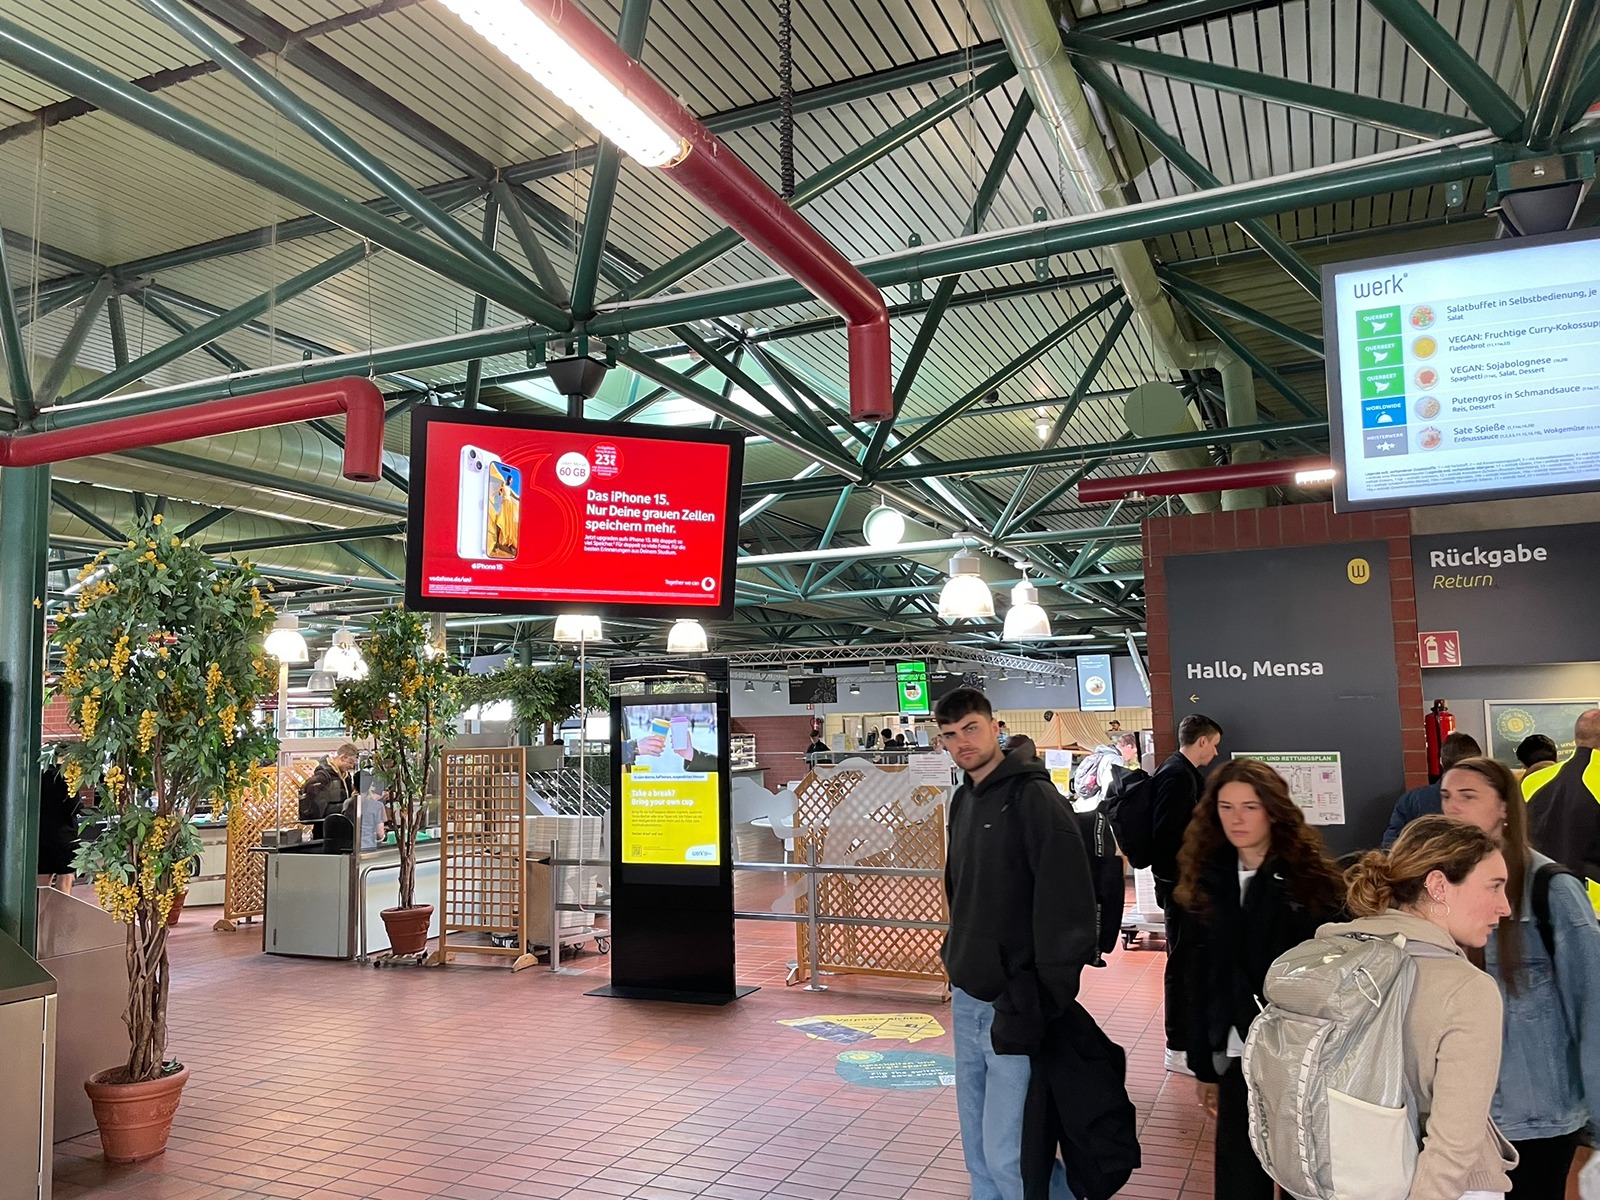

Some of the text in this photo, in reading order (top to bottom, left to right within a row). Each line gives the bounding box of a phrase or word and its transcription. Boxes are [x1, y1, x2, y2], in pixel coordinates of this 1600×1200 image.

[1447, 301, 1497, 313] Salatbuffet
[1509, 291, 1587, 305] Selbstbedienung,
[1588, 288, 1597, 298] je
[1363, 313, 1393, 321] QUERBEET
[1448, 333, 1483, 343] VEGAN:
[1485, 328, 1526, 339] Fruchtige
[1364, 343, 1395, 352] QUERBEET
[1449, 343, 1485, 351] Fladenbrot
[1450, 364, 1484, 374] VEGAN:
[1486, 358, 1551, 371] Sojabolognese
[1366, 373, 1397, 382] QUERBEET
[1450, 374, 1483, 382] Spaghetti
[1518, 367, 1545, 375] Dessert
[1452, 393, 1502, 405] Putengyros
[1504, 391, 1512, 399] in
[1514, 385, 1581, 398] Schmandsauce
[1365, 402, 1401, 411] WORLDWIDE
[1469, 403, 1495, 411] Dessert
[1453, 427, 1473, 435] Sate
[1474, 423, 1506, 433] Spieße
[1453, 434, 1499, 443] Erdnusssauce
[560, 467, 571, 476] 60
[573, 468, 586, 477] GB
[587, 490, 670, 505] Das iPhone 15.
[586, 503, 715, 522] Nur Deine grauen Zellen
[585, 519, 677, 534] speichern mehr.
[1430, 543, 1548, 568] Rückgabe
[476, 563, 496, 571] iPhone
[1432, 574, 1493, 590] Return
[1186, 660, 1324, 681] Hallo, Mensa
[632, 789, 646, 797] Take
[653, 789, 676, 797] break?
[632, 798, 650, 806] Bring
